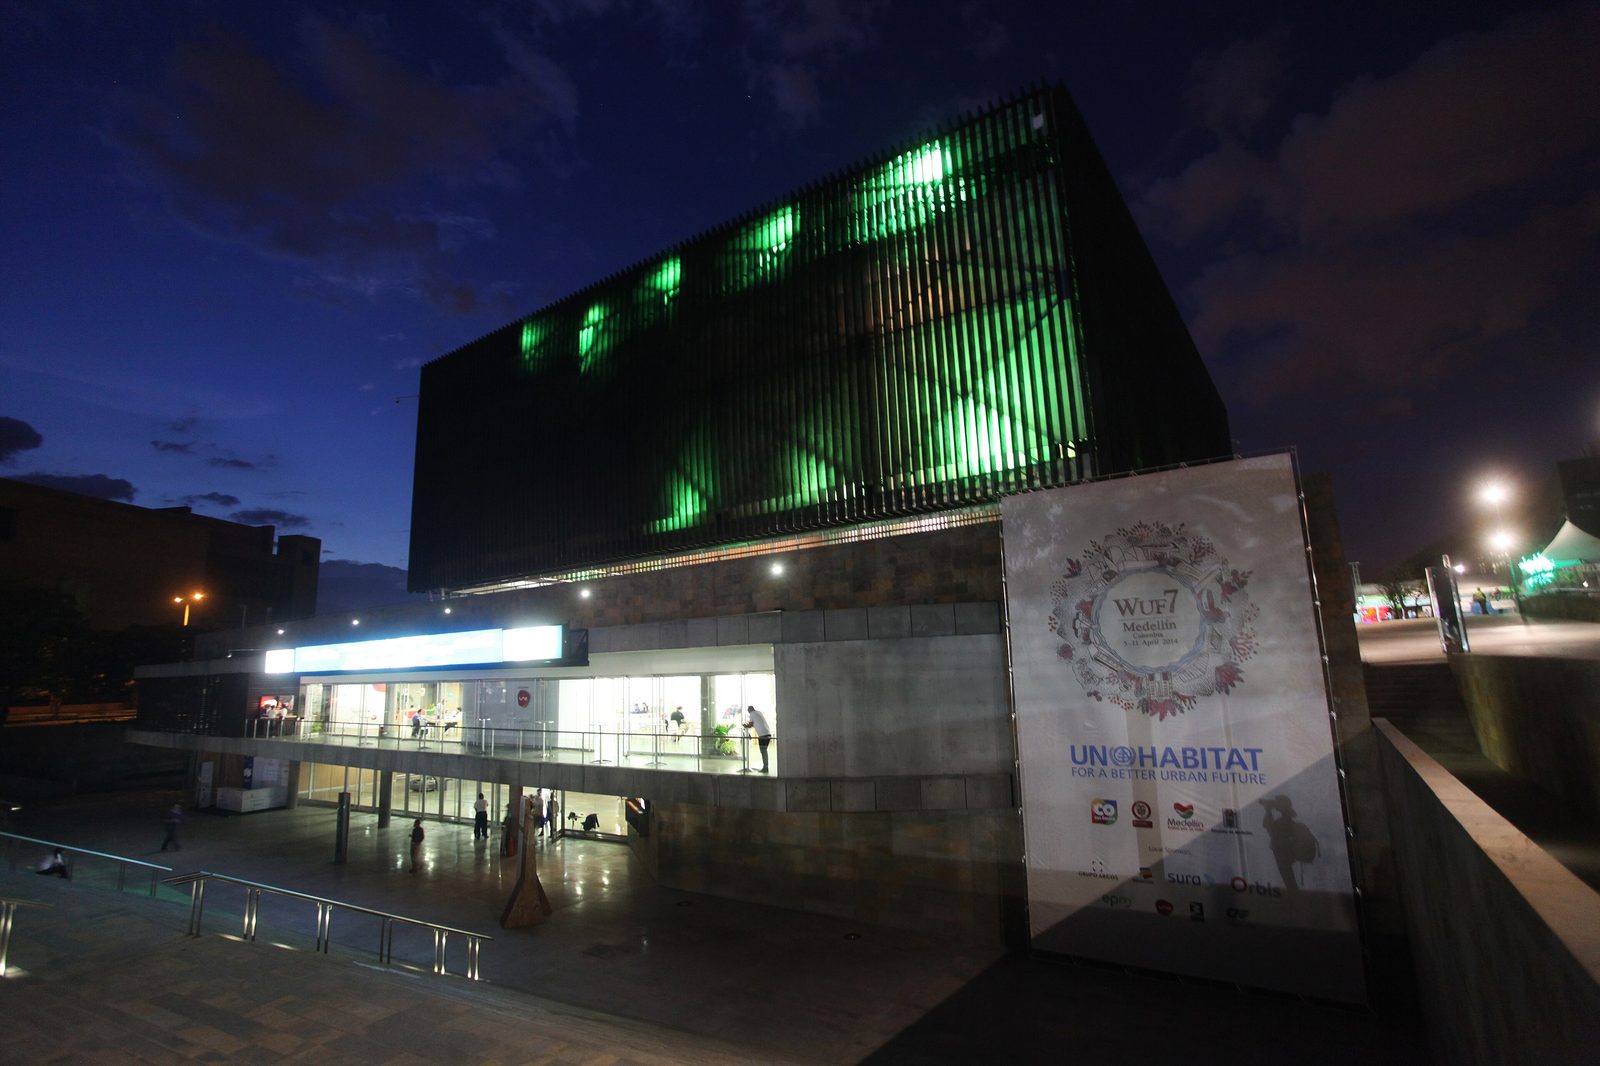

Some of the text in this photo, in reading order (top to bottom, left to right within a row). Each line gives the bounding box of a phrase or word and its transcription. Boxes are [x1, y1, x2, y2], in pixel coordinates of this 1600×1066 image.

[1138, 746, 1264, 771] HABITAT
[1071, 767, 1267, 785] FOR A BETTER URBAN FUTURE
[1168, 872, 1202, 886] sura
[1231, 876, 1282, 897] Orbis
